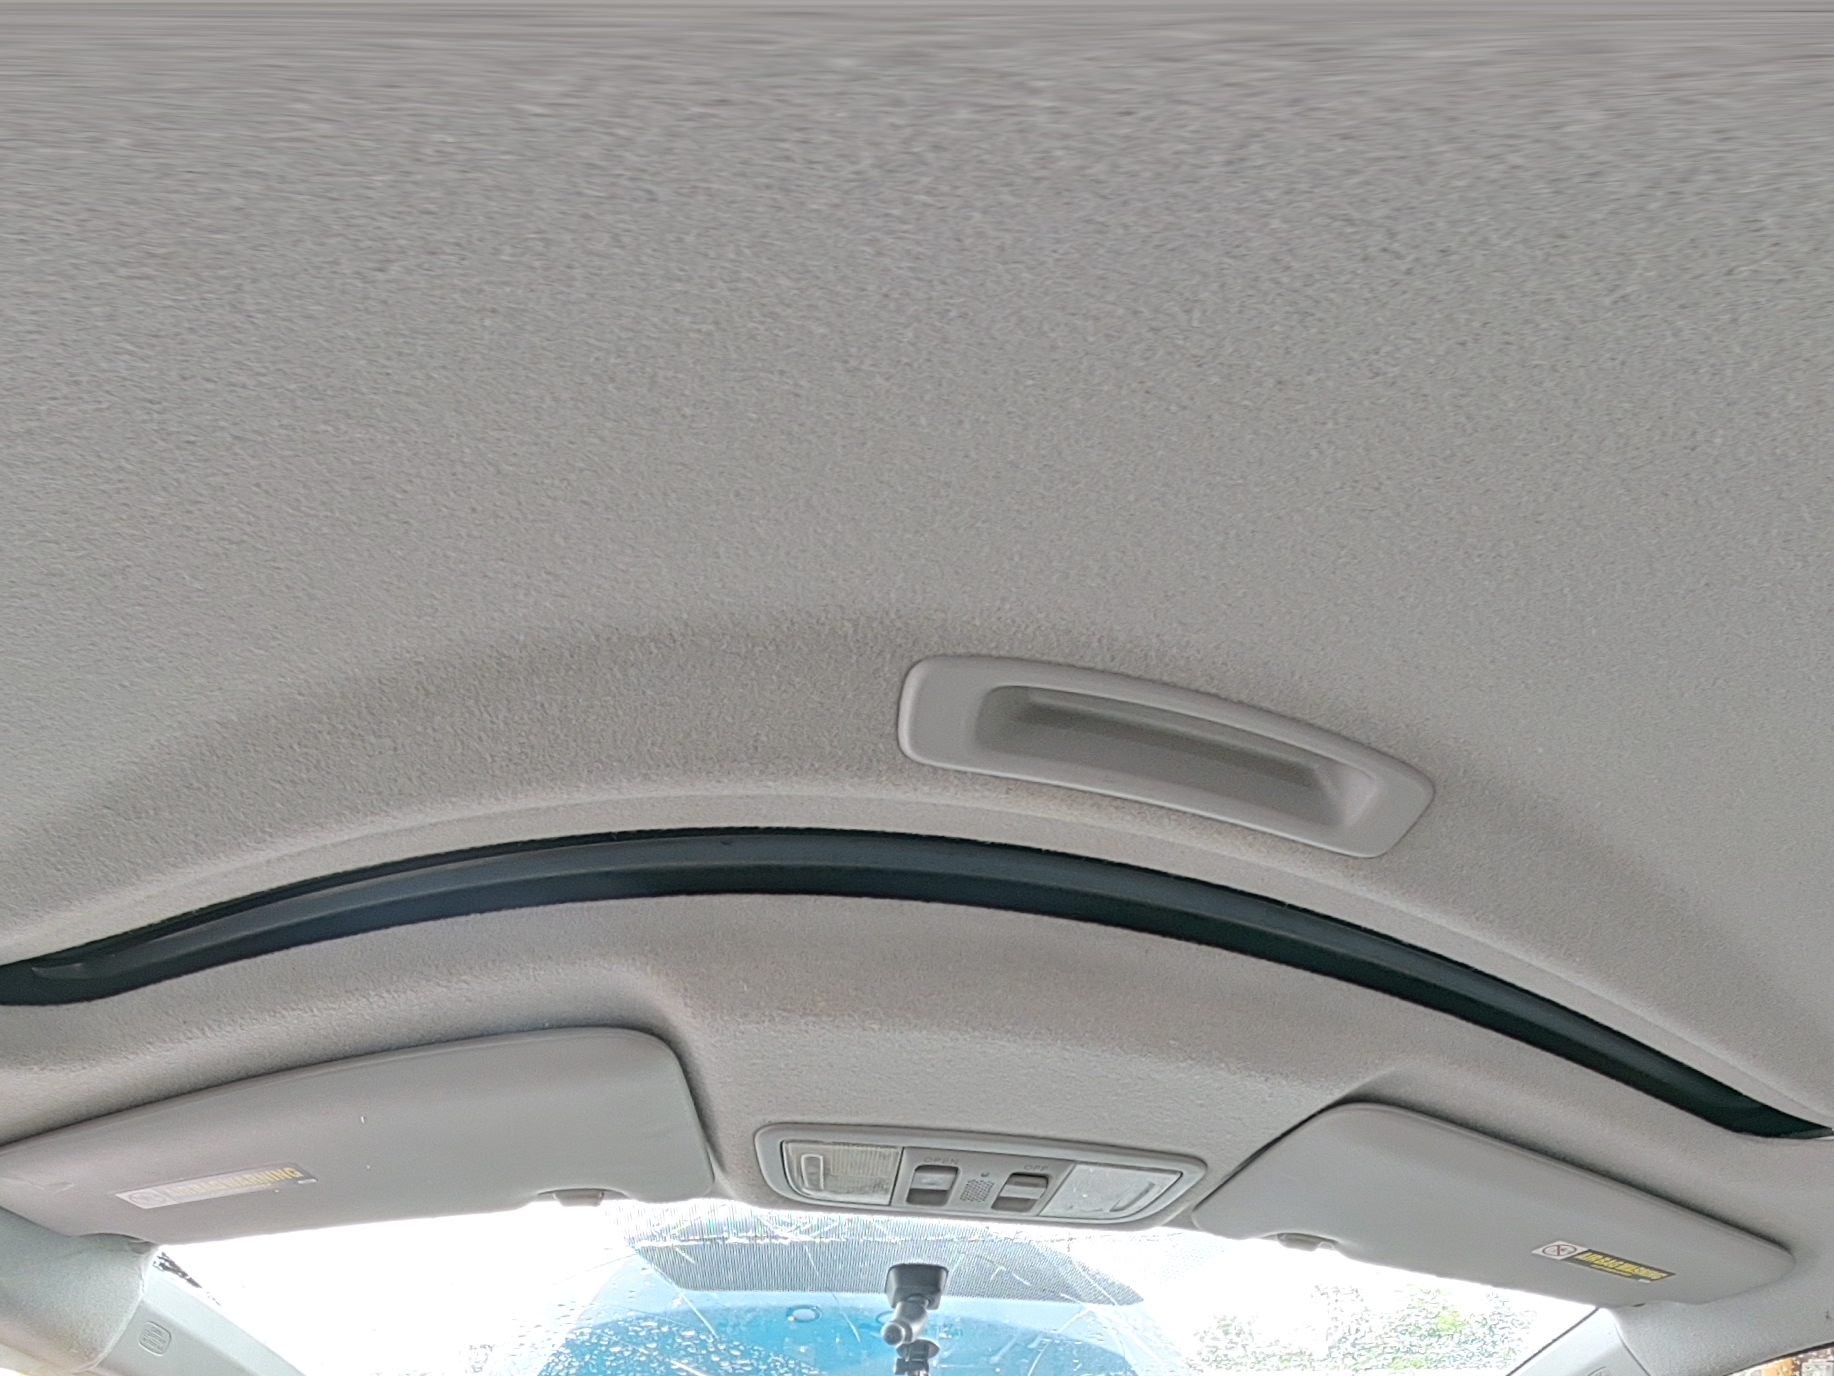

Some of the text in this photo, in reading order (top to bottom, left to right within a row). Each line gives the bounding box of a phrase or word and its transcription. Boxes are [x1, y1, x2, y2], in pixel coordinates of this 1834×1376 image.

[923, 1156, 959, 1166] OPEN
[1023, 1163, 1049, 1172] OFF
[220, 1167, 304, 1189] WARNING
